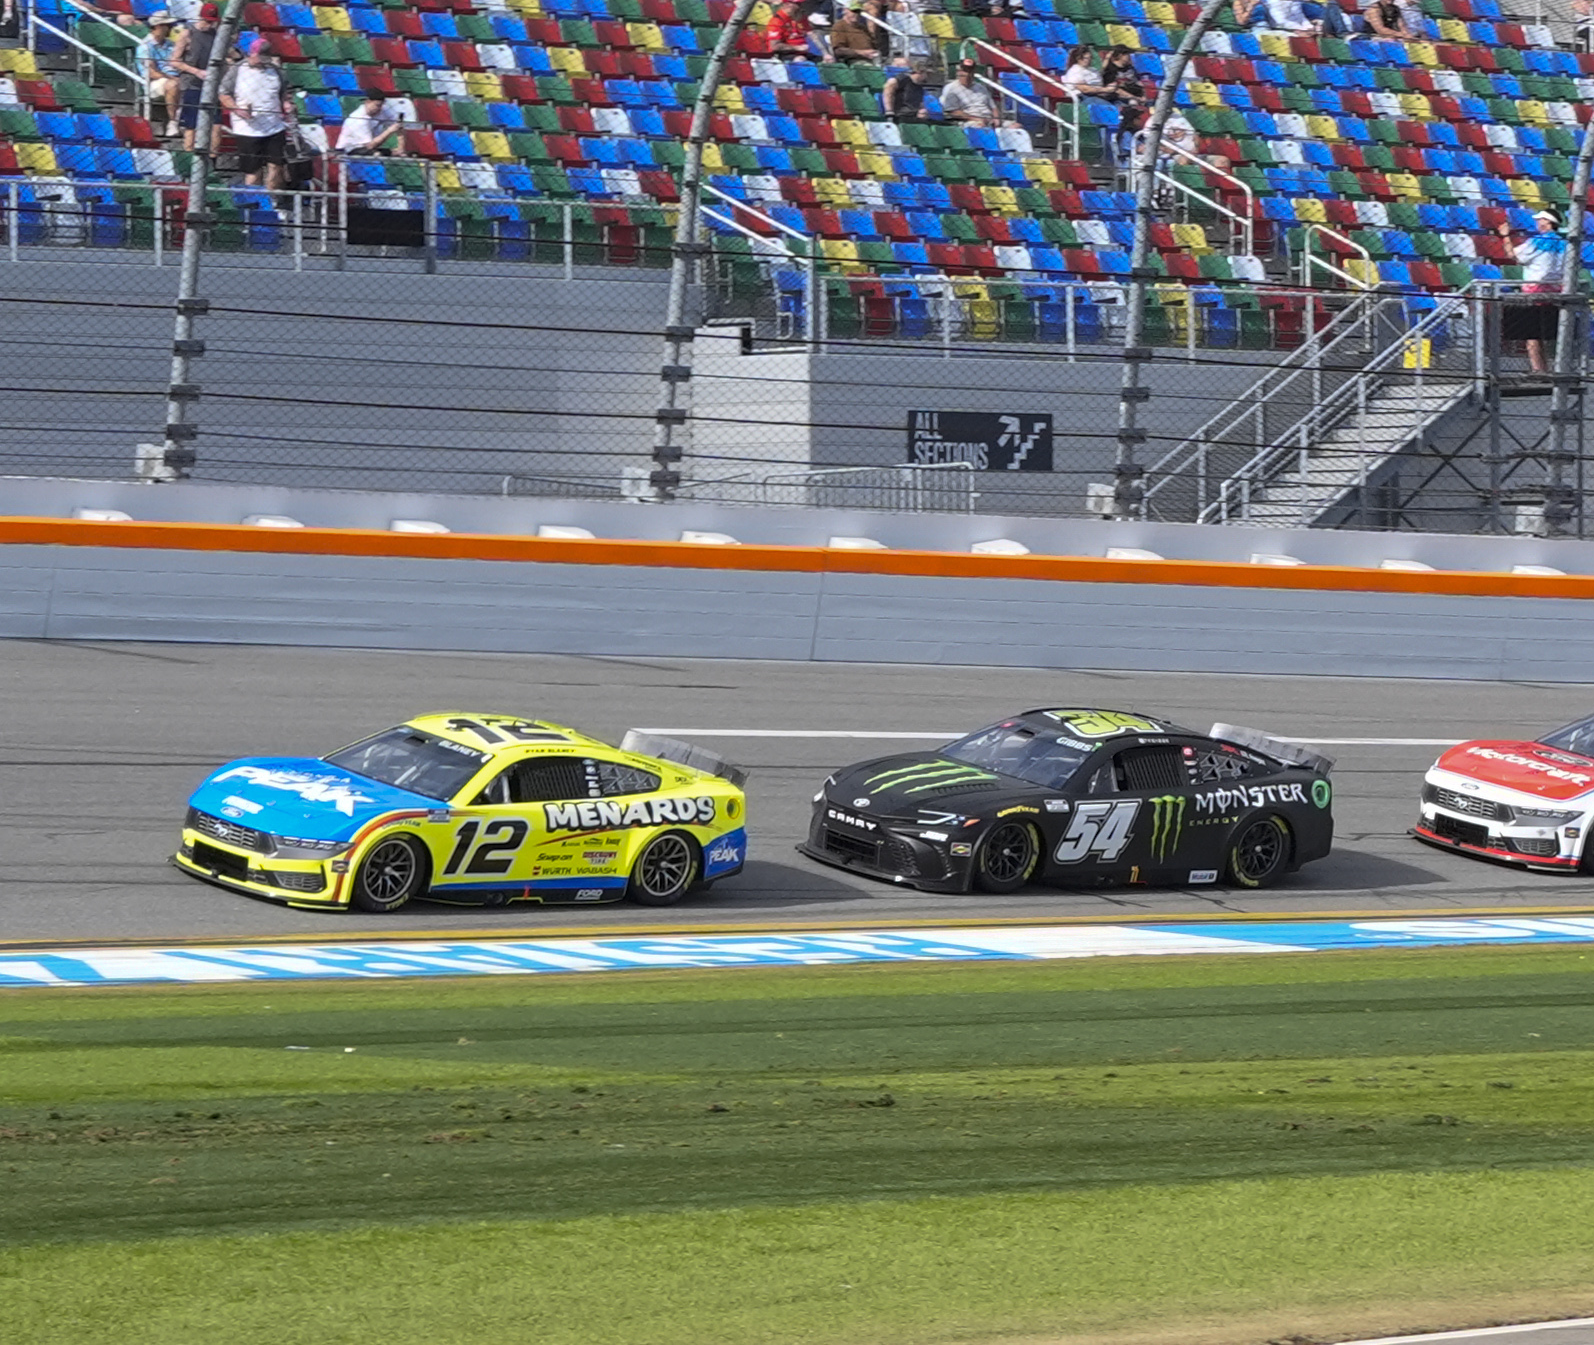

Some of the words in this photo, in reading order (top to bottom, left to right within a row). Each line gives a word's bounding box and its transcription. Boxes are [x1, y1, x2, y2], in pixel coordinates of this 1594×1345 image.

[914, 412, 942, 439] ALL
[914, 442, 989, 472] SECTIONS
[1044, 710, 1164, 738] 54
[438, 740, 480, 757] BLANEY
[1056, 736, 1093, 752] GIBBS
[1195, 783, 1308, 815] MONSTER
[545, 796, 715, 832] MENARDS
[828, 809, 876, 831] CAMRY
[1189, 816, 1239, 827] ENERGY
[1054, 799, 1142, 864] 54
[443, 820, 528, 876] 12
[709, 847, 740, 865] PEAK
[576, 889, 603, 897] FORD
